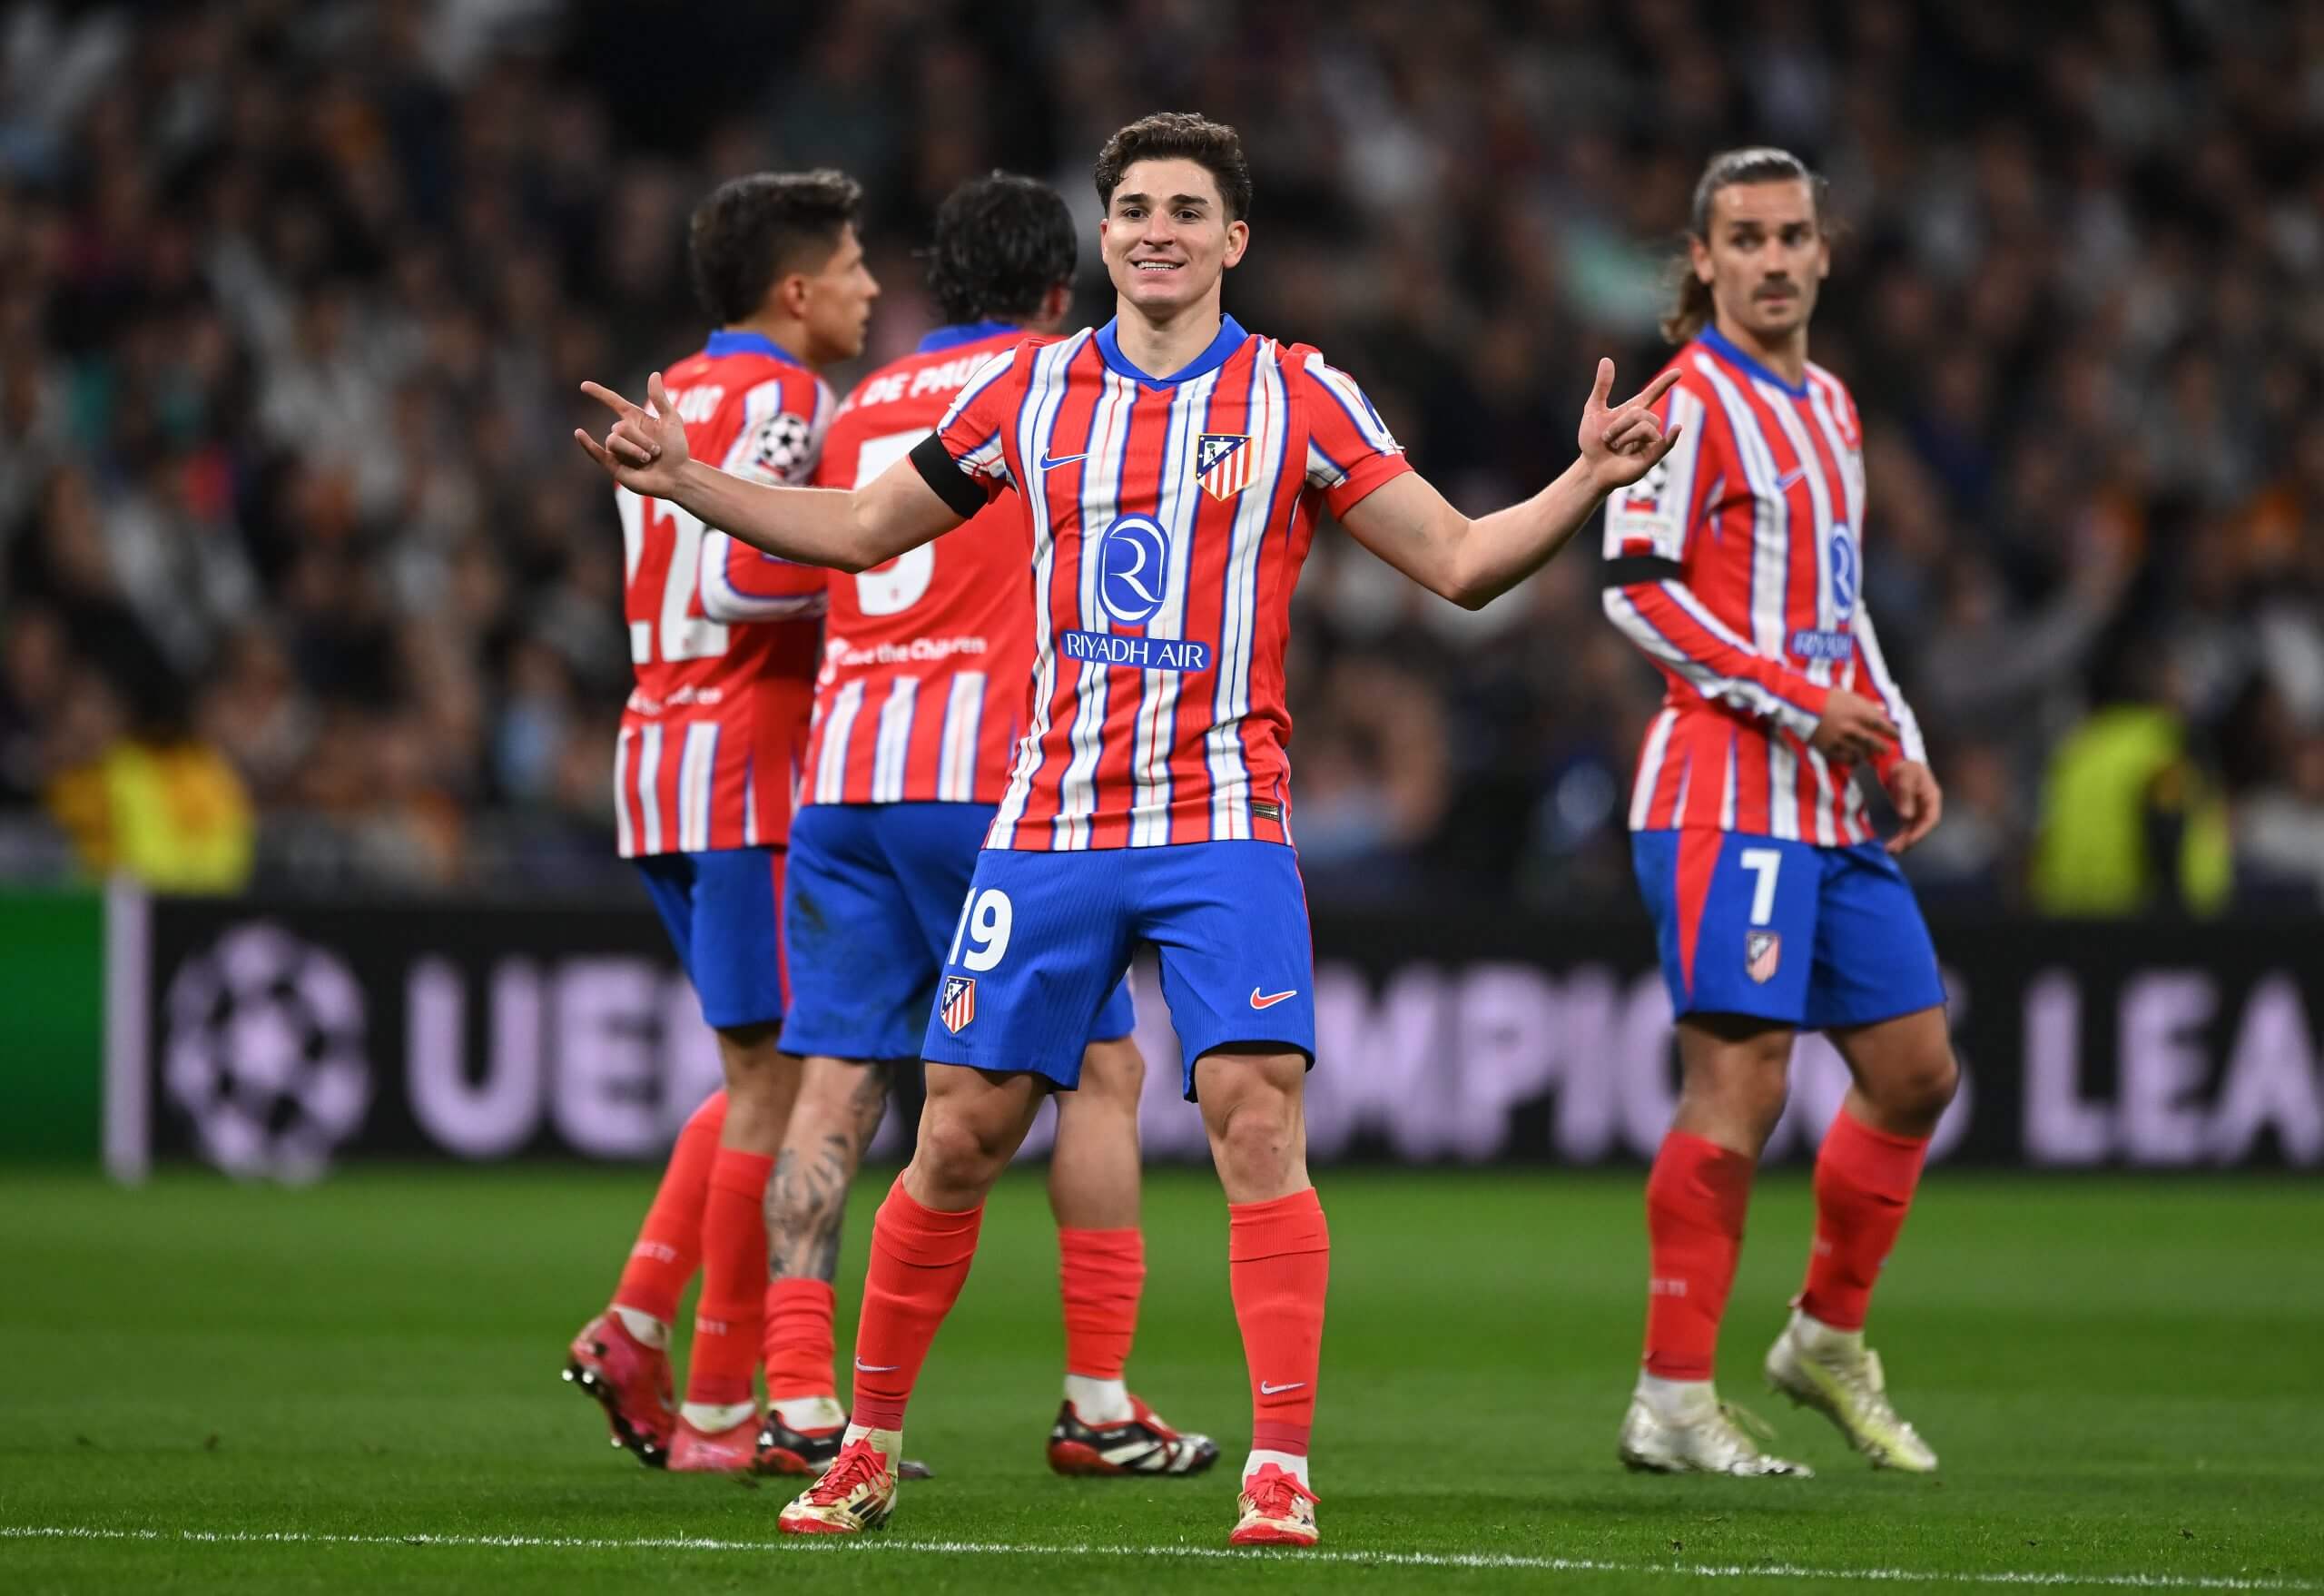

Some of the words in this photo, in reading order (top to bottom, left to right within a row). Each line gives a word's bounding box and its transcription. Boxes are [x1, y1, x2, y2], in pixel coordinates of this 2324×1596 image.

[909, 350, 996, 399] PAU
[853, 427, 936, 617] 5
[1066, 633, 1148, 665] RIYADH
[1157, 643, 1204, 669] AIR
[1740, 847, 1783, 926] 7
[948, 886, 1013, 972] 19
